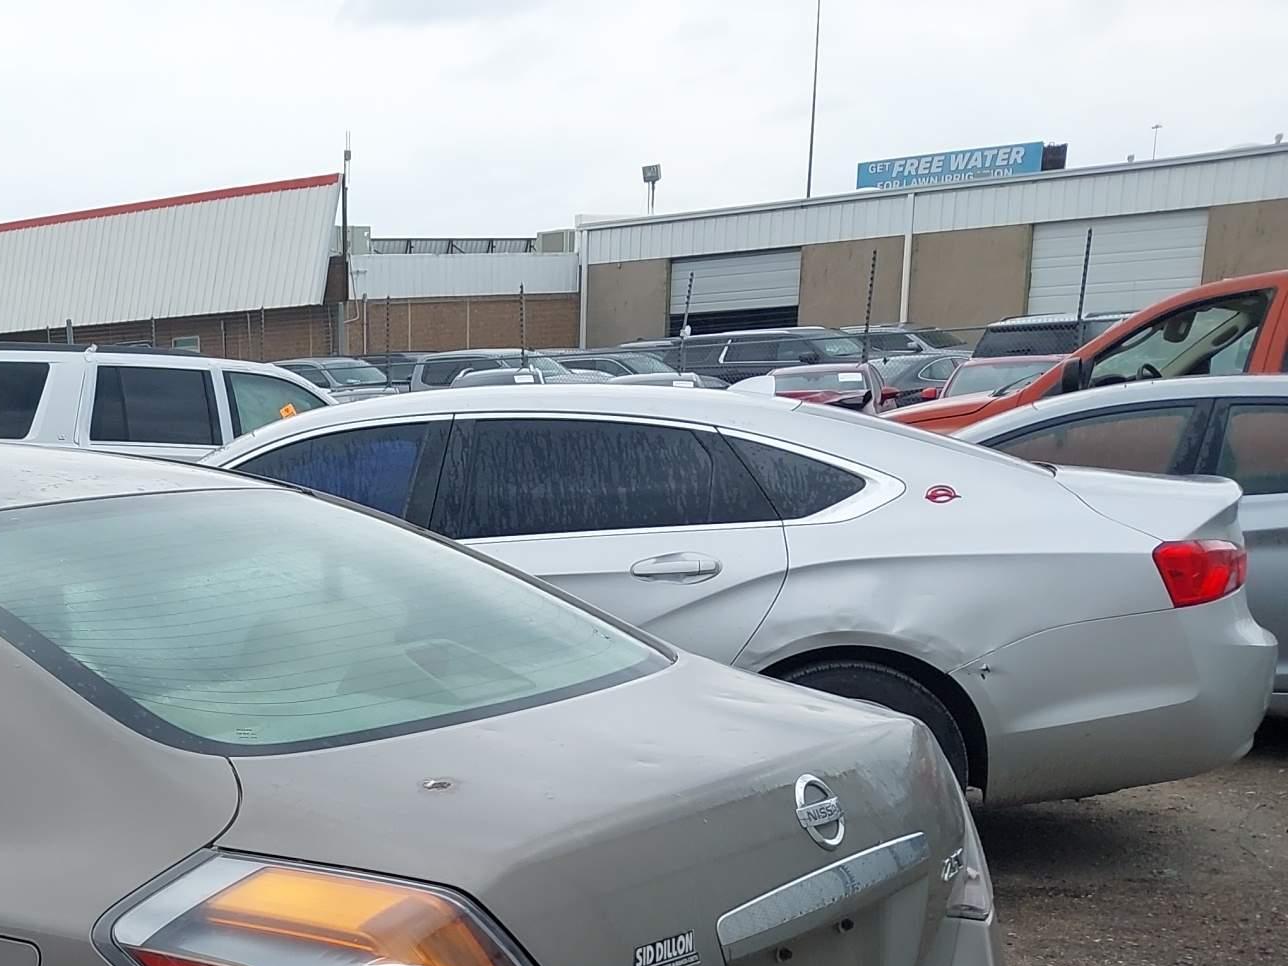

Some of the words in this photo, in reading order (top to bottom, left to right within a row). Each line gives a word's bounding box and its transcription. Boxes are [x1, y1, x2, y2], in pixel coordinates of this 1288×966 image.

[868, 162, 890, 174] GET
[892, 154, 947, 177] FREE
[948, 146, 1025, 171] WATER
[941, 167, 1013, 184] IRRIGION
[806, 802, 839, 822] NISS
[655, 931, 693, 962] DILLON
